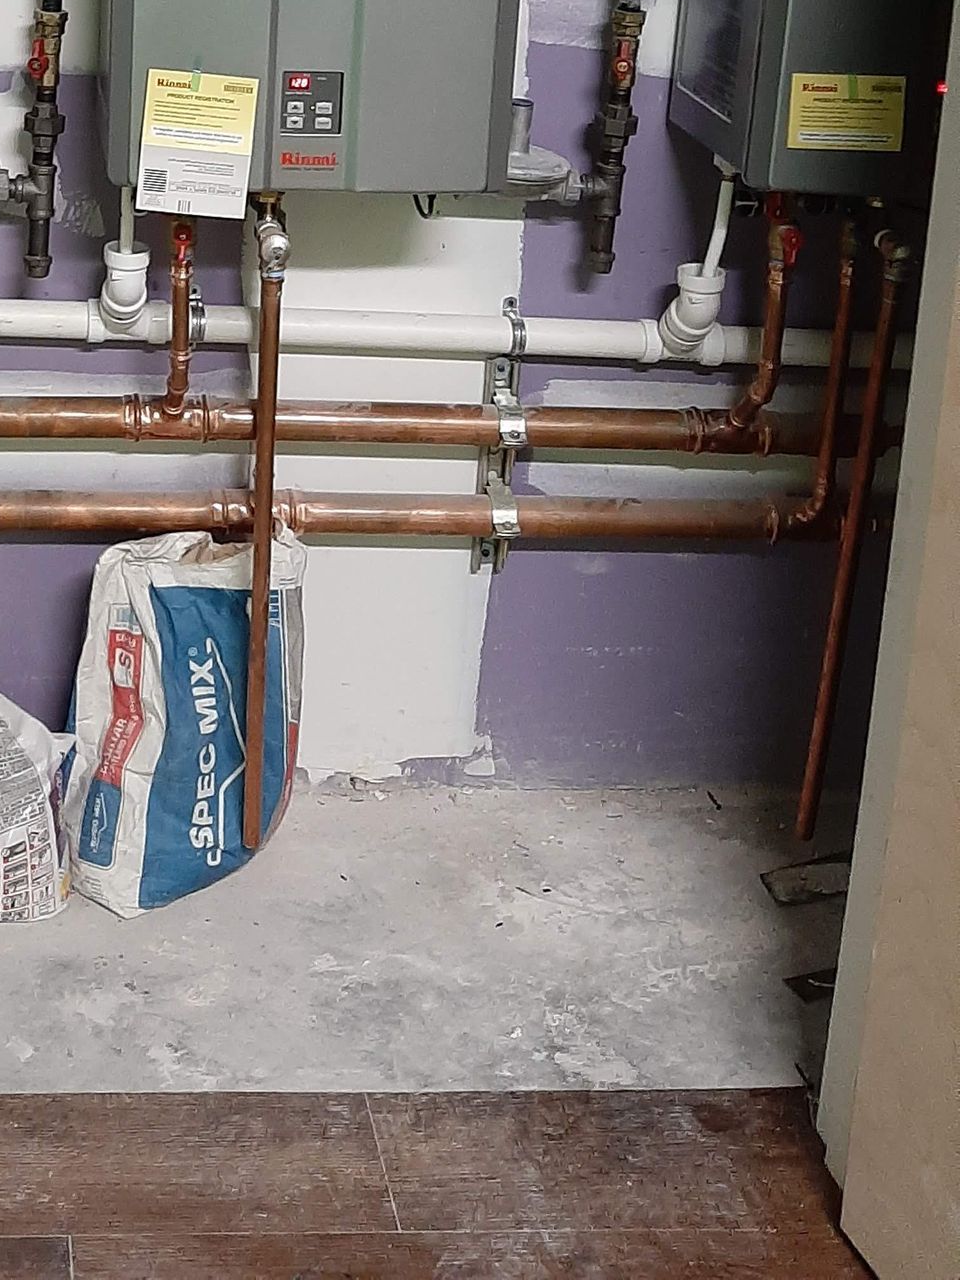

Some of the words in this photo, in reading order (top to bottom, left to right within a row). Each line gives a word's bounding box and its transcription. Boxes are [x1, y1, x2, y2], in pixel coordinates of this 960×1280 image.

[157, 78, 192, 90] Rinnai
[291, 78, 309, 88] 120
[167, 92, 194, 101] PRODUCT
[281, 152, 337, 166] Rinnai
[189, 657, 219, 735] MIX
[189, 742, 216, 849] SPEC
